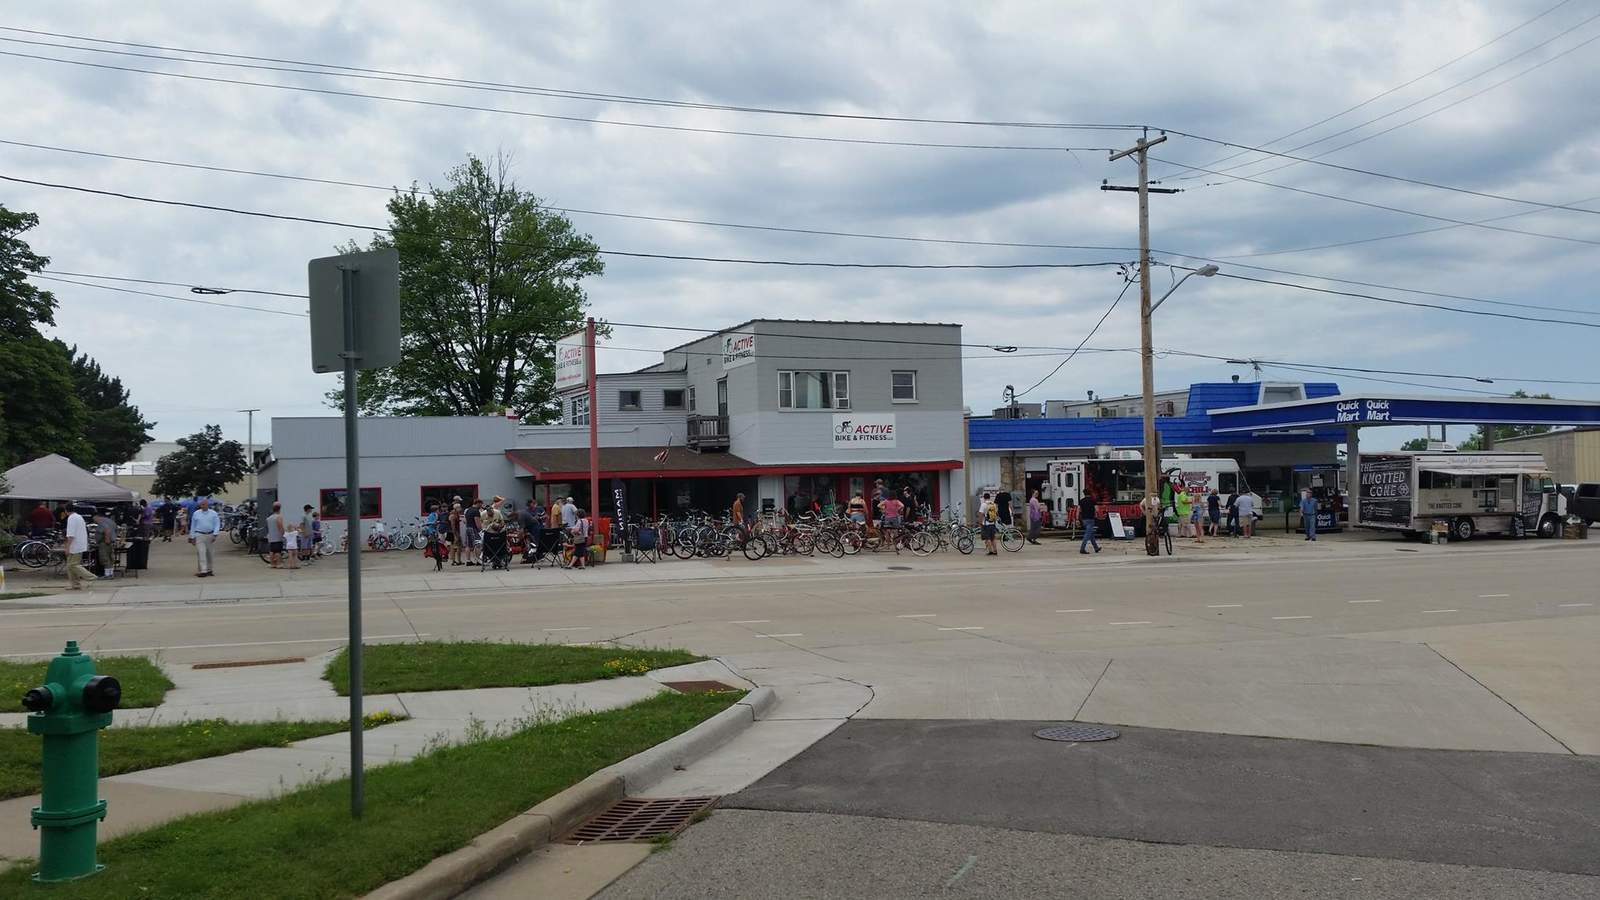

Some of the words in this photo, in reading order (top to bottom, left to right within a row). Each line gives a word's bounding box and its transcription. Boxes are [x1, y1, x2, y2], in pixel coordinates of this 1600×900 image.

[733, 336, 753, 353] ACTIVE
[564, 347, 582, 360] ACTIVE
[724, 354, 732, 364] BIKE
[735, 350, 750, 360] FITNESS
[1337, 401, 1359, 412] Quick
[1367, 400, 1389, 410] Quick
[1337, 411, 1360, 422] Mart
[1367, 411, 1390, 421] Mart
[855, 424, 893, 434] ACTIVE
[1360, 463, 1373, 472] THE
[1362, 471, 1405, 485] KNOTTED
[1369, 484, 1397, 497] CONE
